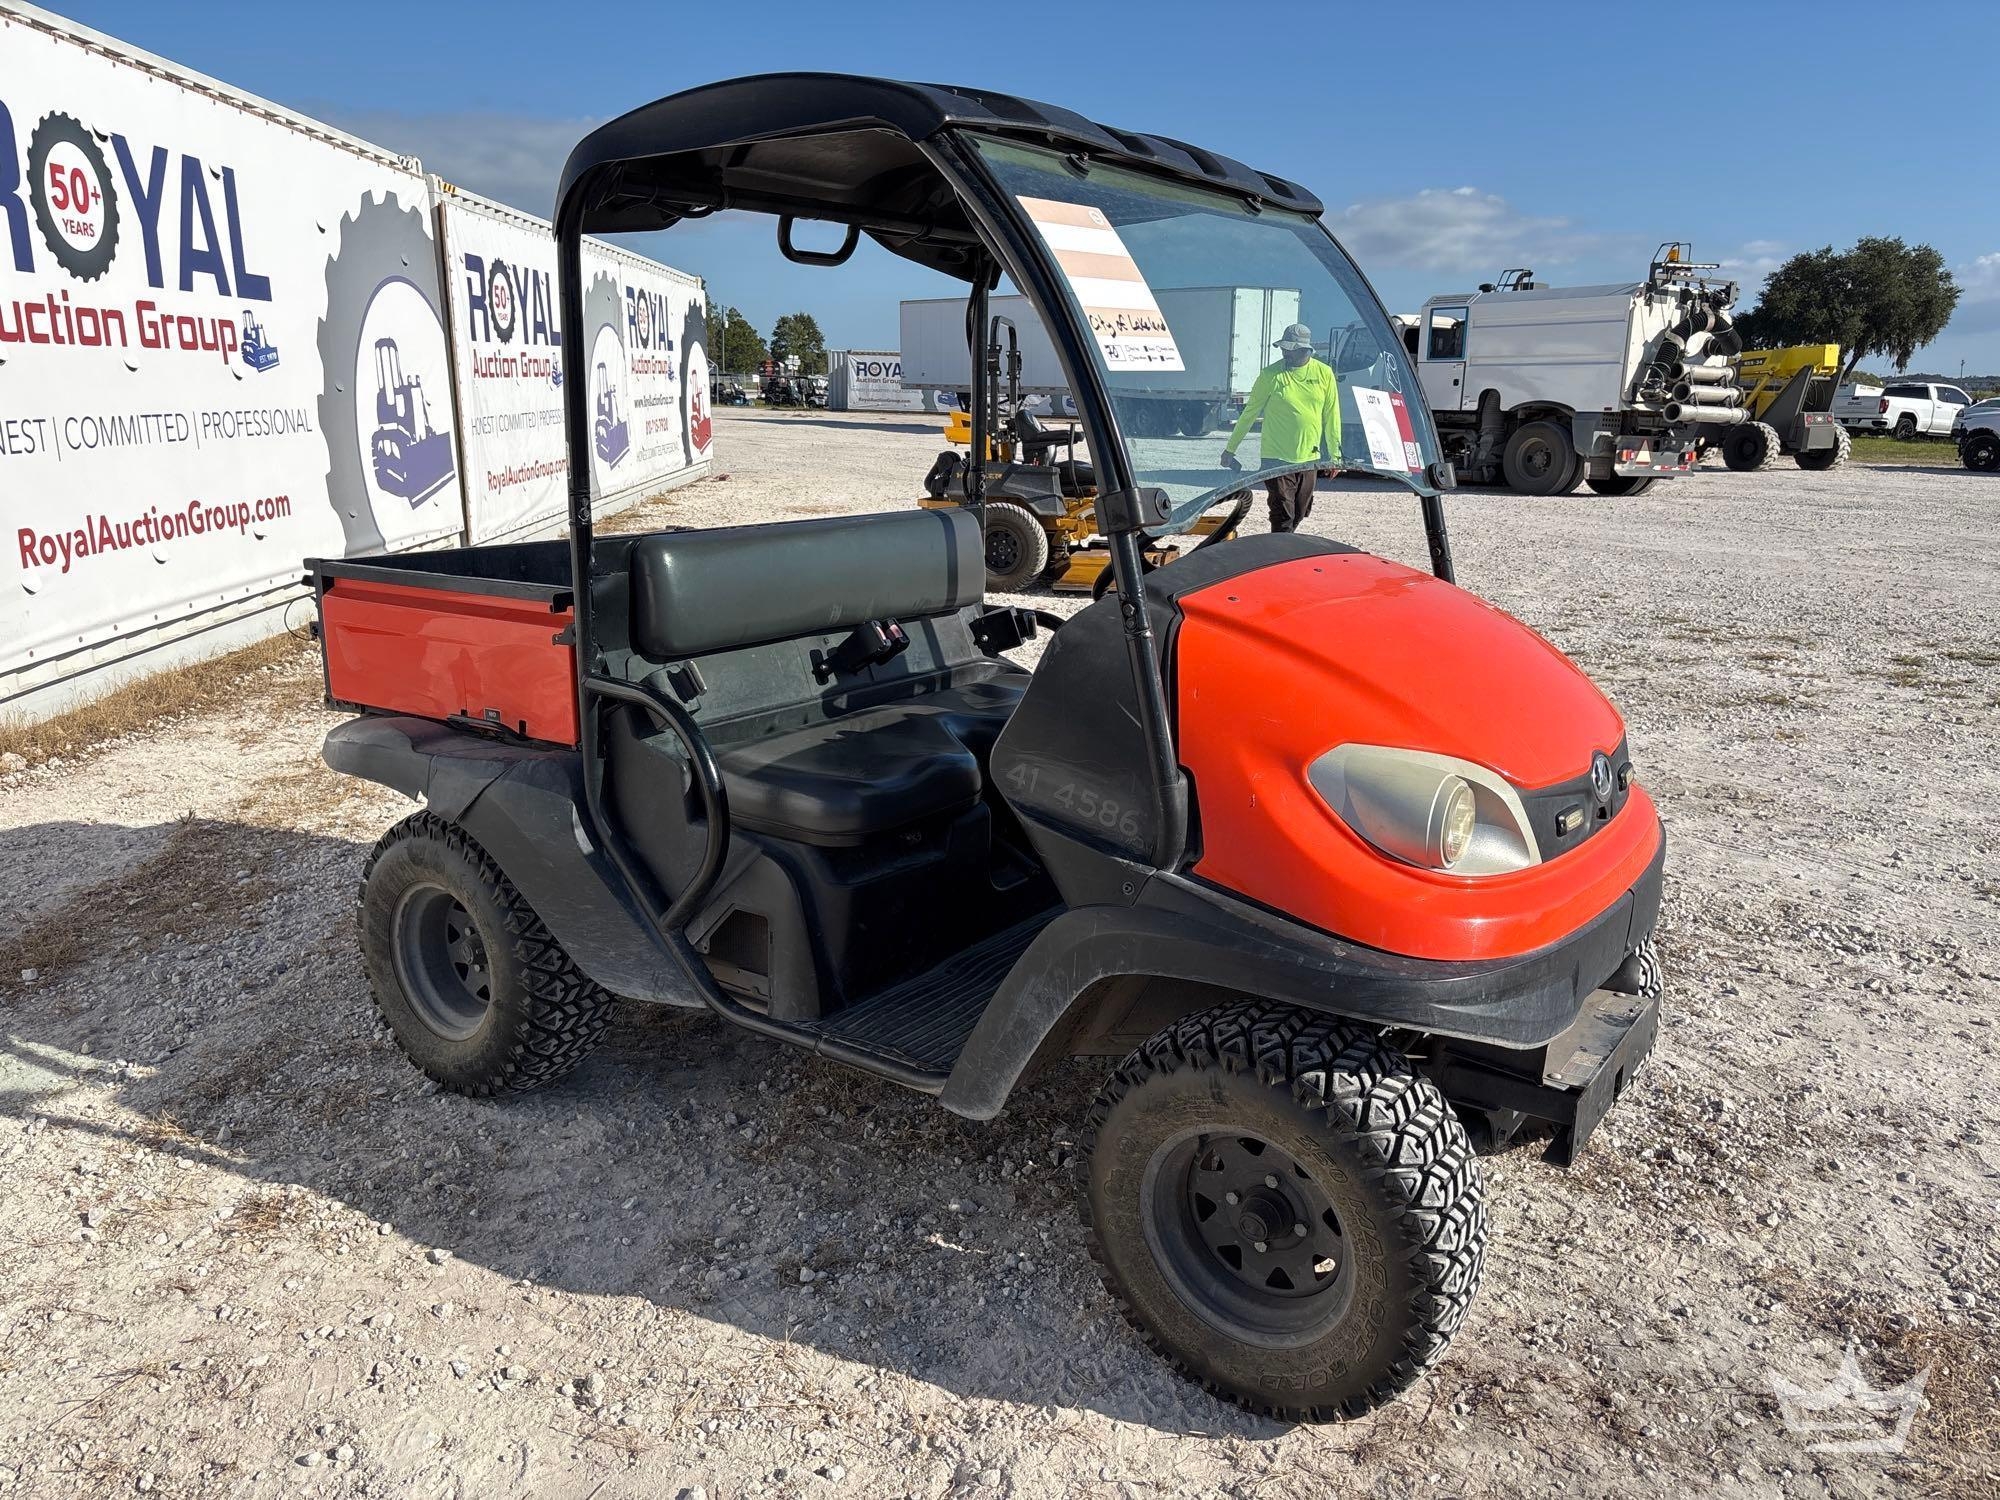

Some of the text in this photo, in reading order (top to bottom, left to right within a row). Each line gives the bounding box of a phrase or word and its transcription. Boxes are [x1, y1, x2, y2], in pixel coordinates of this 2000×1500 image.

[49, 163, 101, 215] 50+
[62, 218, 95, 238] YEARS
[464, 252, 561, 347] ROYAL
[494, 285, 511, 309] 50+
[626, 286, 674, 351] ROYAL
[0, 289, 238, 365] uction Group
[473, 349, 551, 384] Auction Group
[856, 362, 901, 378] ROYA
[65, 412, 189, 450] COMMITTED
[202, 408, 313, 441] PROFESSIONAL
[471, 415, 495, 435] HONEST
[498, 411, 537, 432] COMMITTED
[18, 493, 291, 574] RoyalAuctionGroup.com
[1053, 783, 1140, 836] 4586
